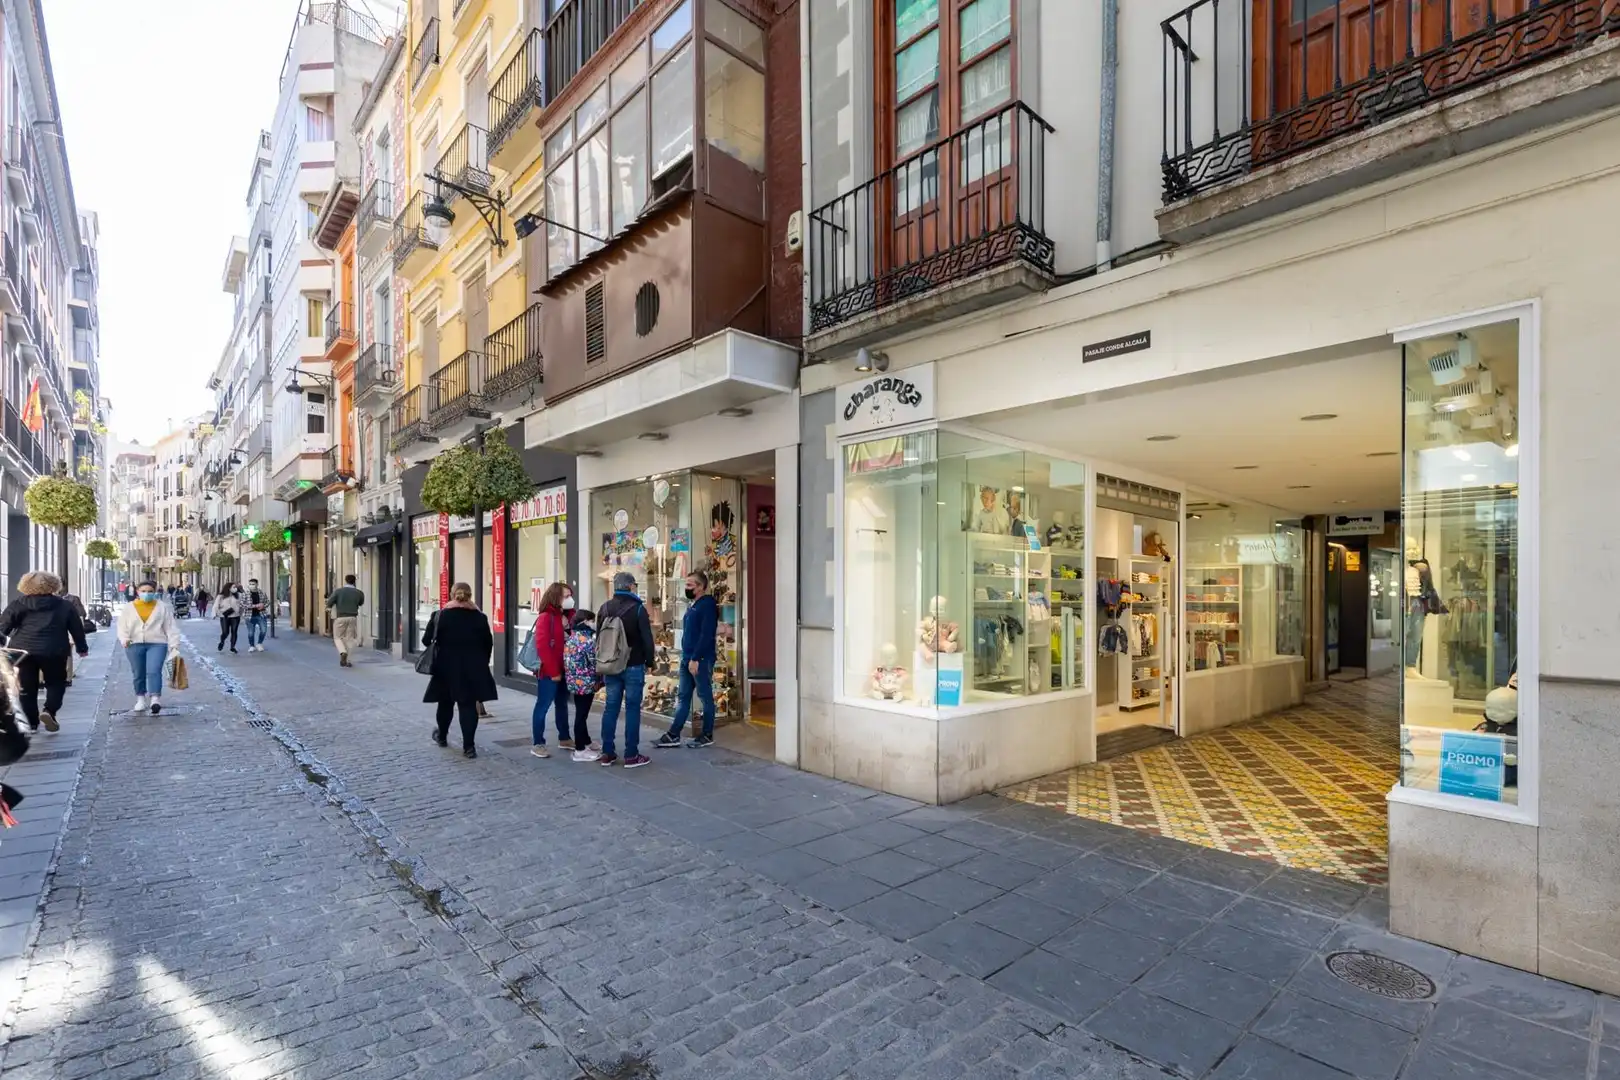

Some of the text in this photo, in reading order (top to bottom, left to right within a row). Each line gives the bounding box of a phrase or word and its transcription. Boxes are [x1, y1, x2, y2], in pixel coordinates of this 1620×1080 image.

[1084, 335, 1148, 357] PASAJE CONDE ALCALÁ
[544, 494, 553, 516] 70
[556, 491, 566, 514] 60
[531, 587, 541, 614] 70
[1447, 752, 1496, 768] PROMO
